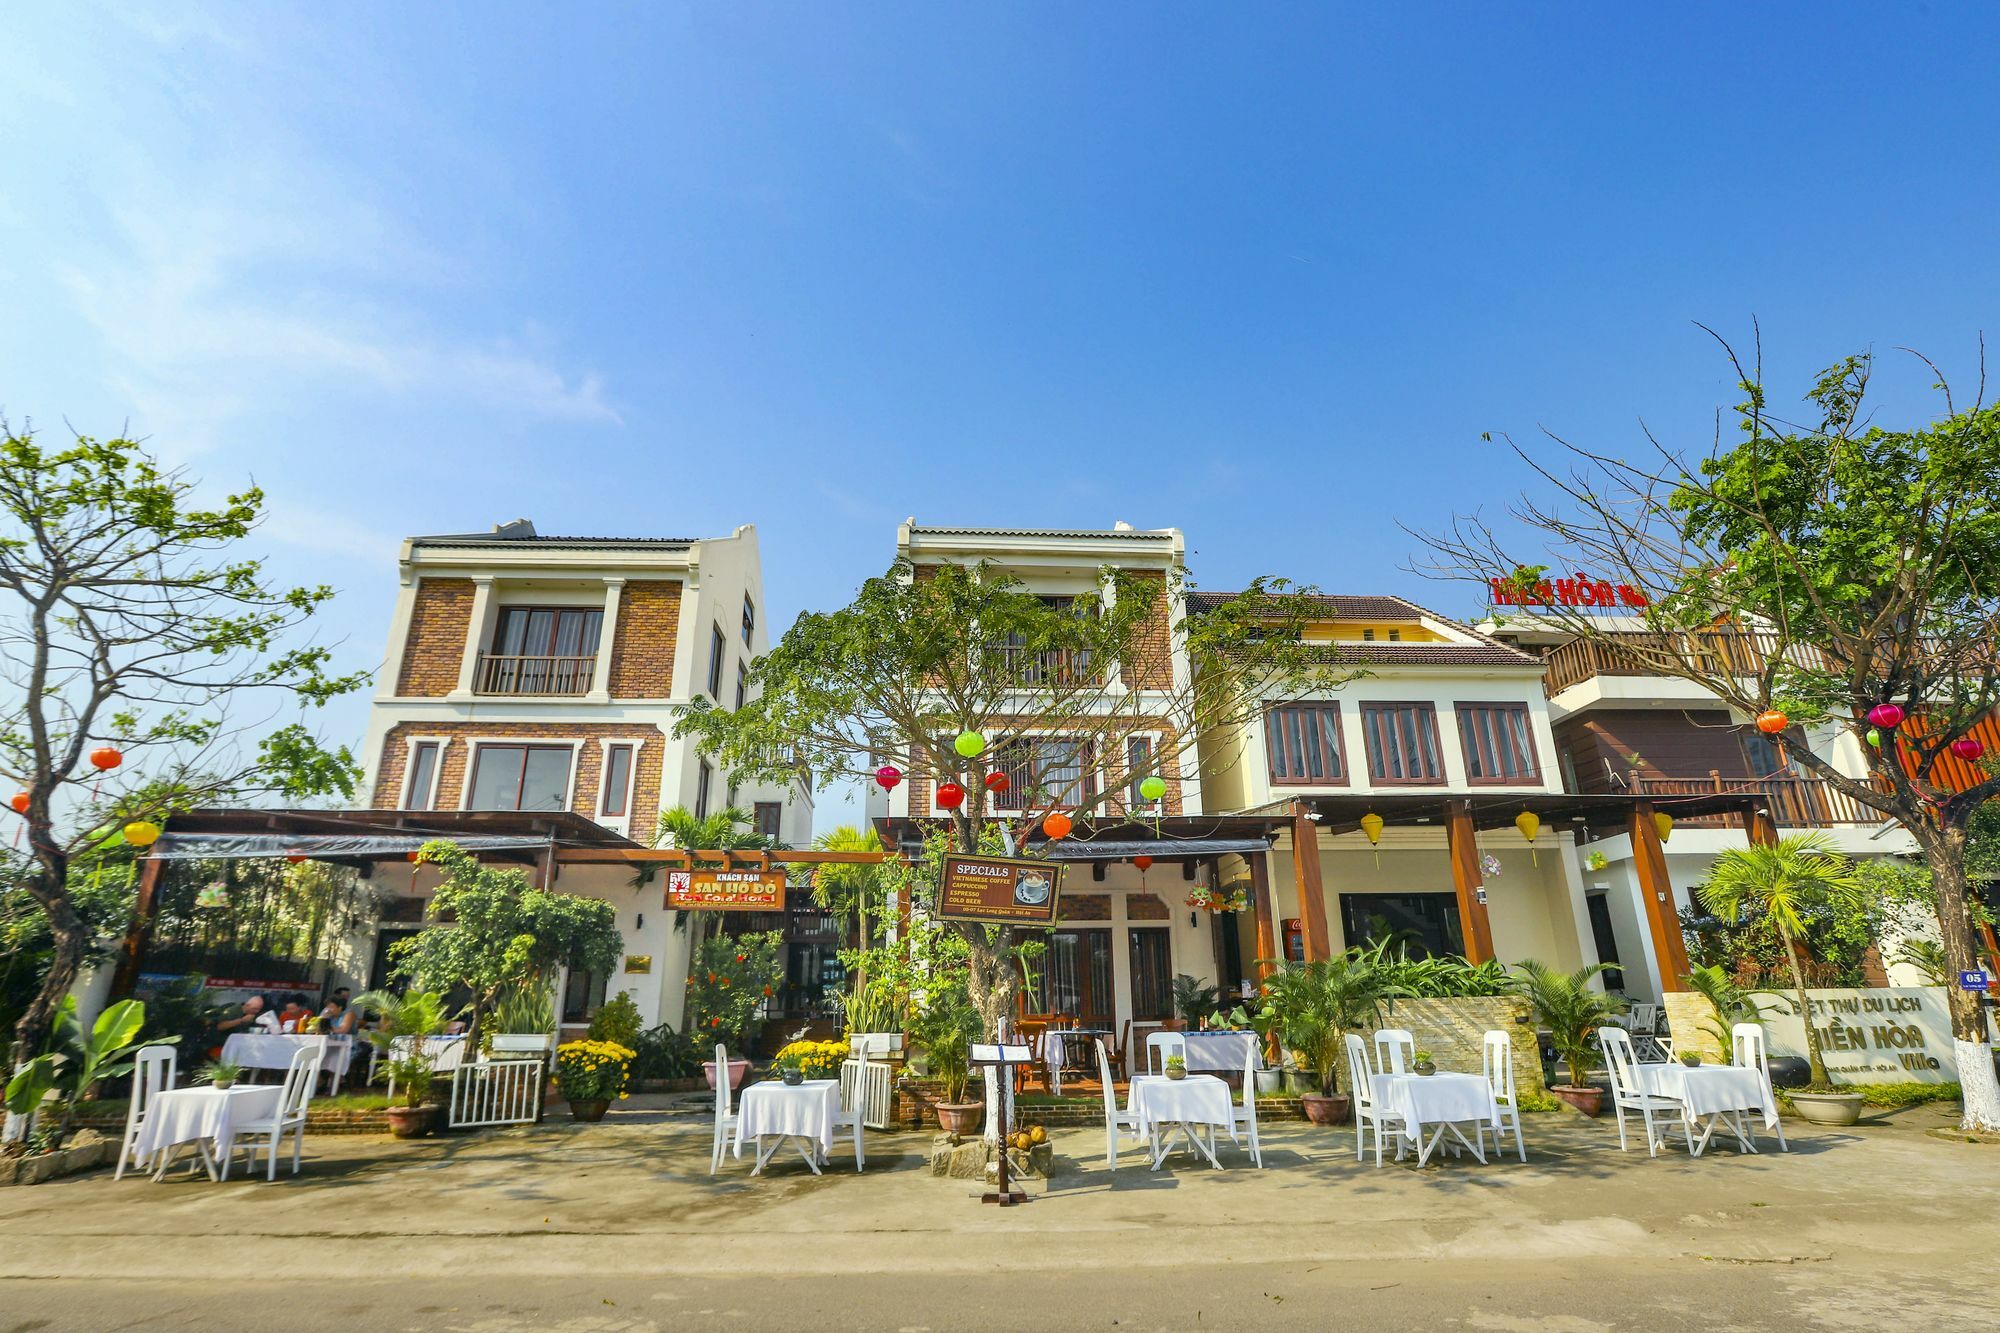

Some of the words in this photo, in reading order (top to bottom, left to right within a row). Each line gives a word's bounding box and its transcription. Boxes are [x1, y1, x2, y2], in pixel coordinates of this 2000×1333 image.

[957, 865, 1009, 877] SPECIALS
[716, 873, 741, 881] KHÁCH
[743, 873, 760, 883] SẠN
[952, 875, 988, 883] VIETNAMESE
[694, 882, 721, 893] SAN
[752, 880, 777, 894] ĐỎ
[676, 893, 703, 902] Red
[704, 893, 736, 902] Coral
[738, 894, 775, 902] Hotel
[1966, 974, 1981, 983] 05
[1829, 997, 1859, 1016] THỰ
[1862, 998, 1884, 1013] DU
[1886, 997, 1923, 1015] LỊCH
[1869, 1019, 1926, 1050] HÒA
